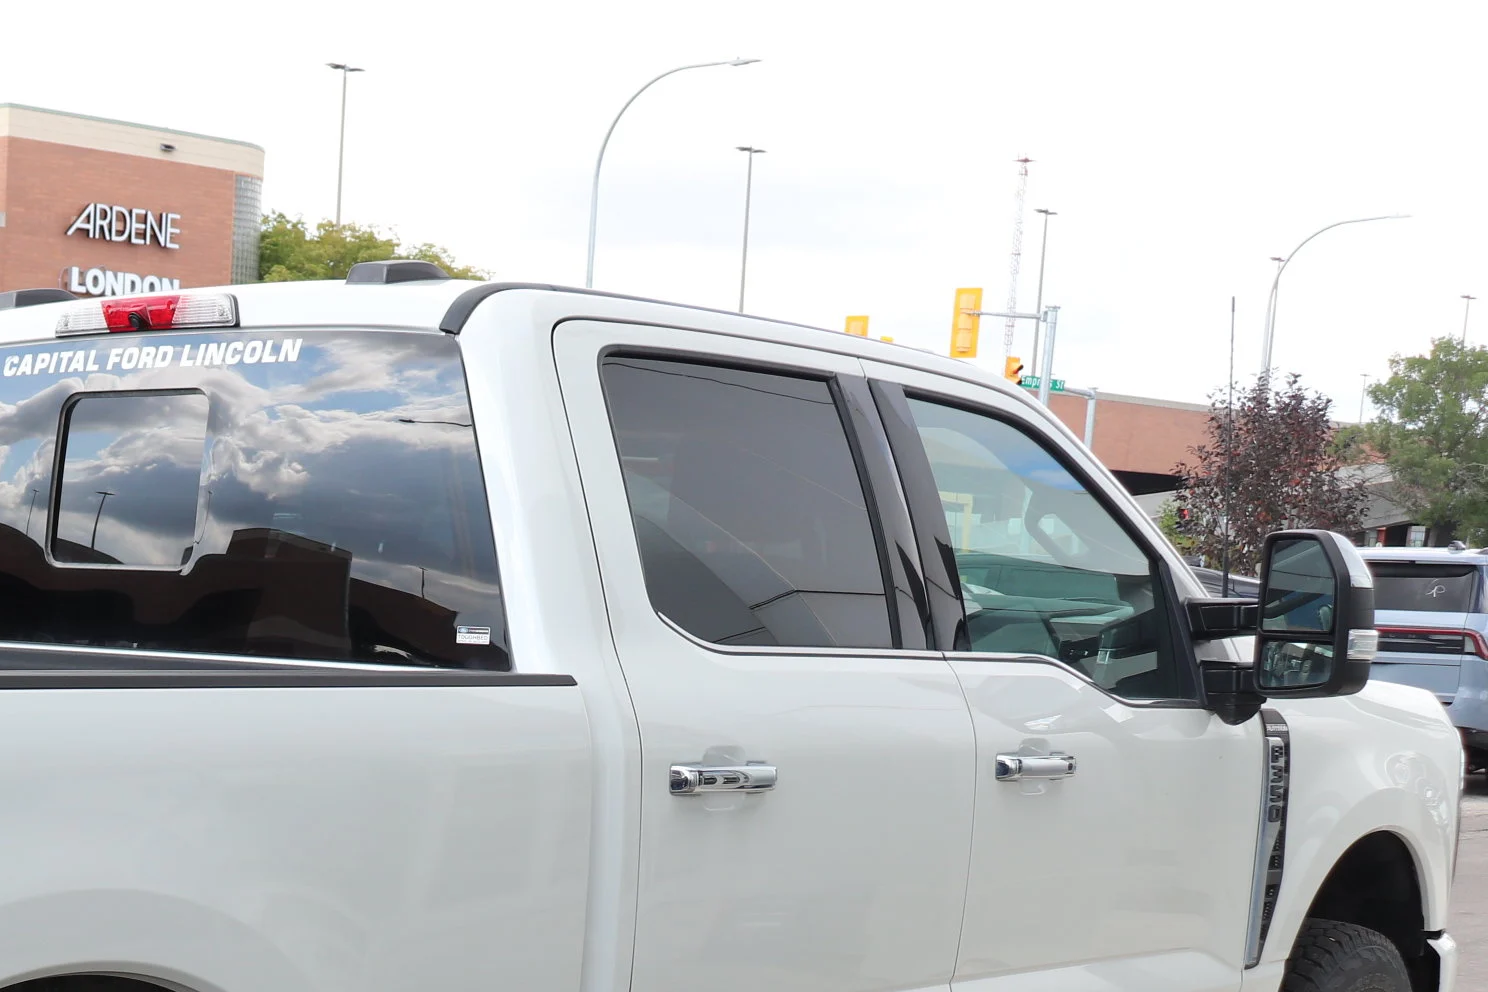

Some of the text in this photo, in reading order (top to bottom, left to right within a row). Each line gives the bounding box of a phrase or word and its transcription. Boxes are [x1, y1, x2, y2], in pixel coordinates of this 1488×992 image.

[66, 203, 181, 249] ARDENE
[3, 338, 303, 377] CAPITAL FORD LINCOLN
[1056, 381, 1064, 390] St
